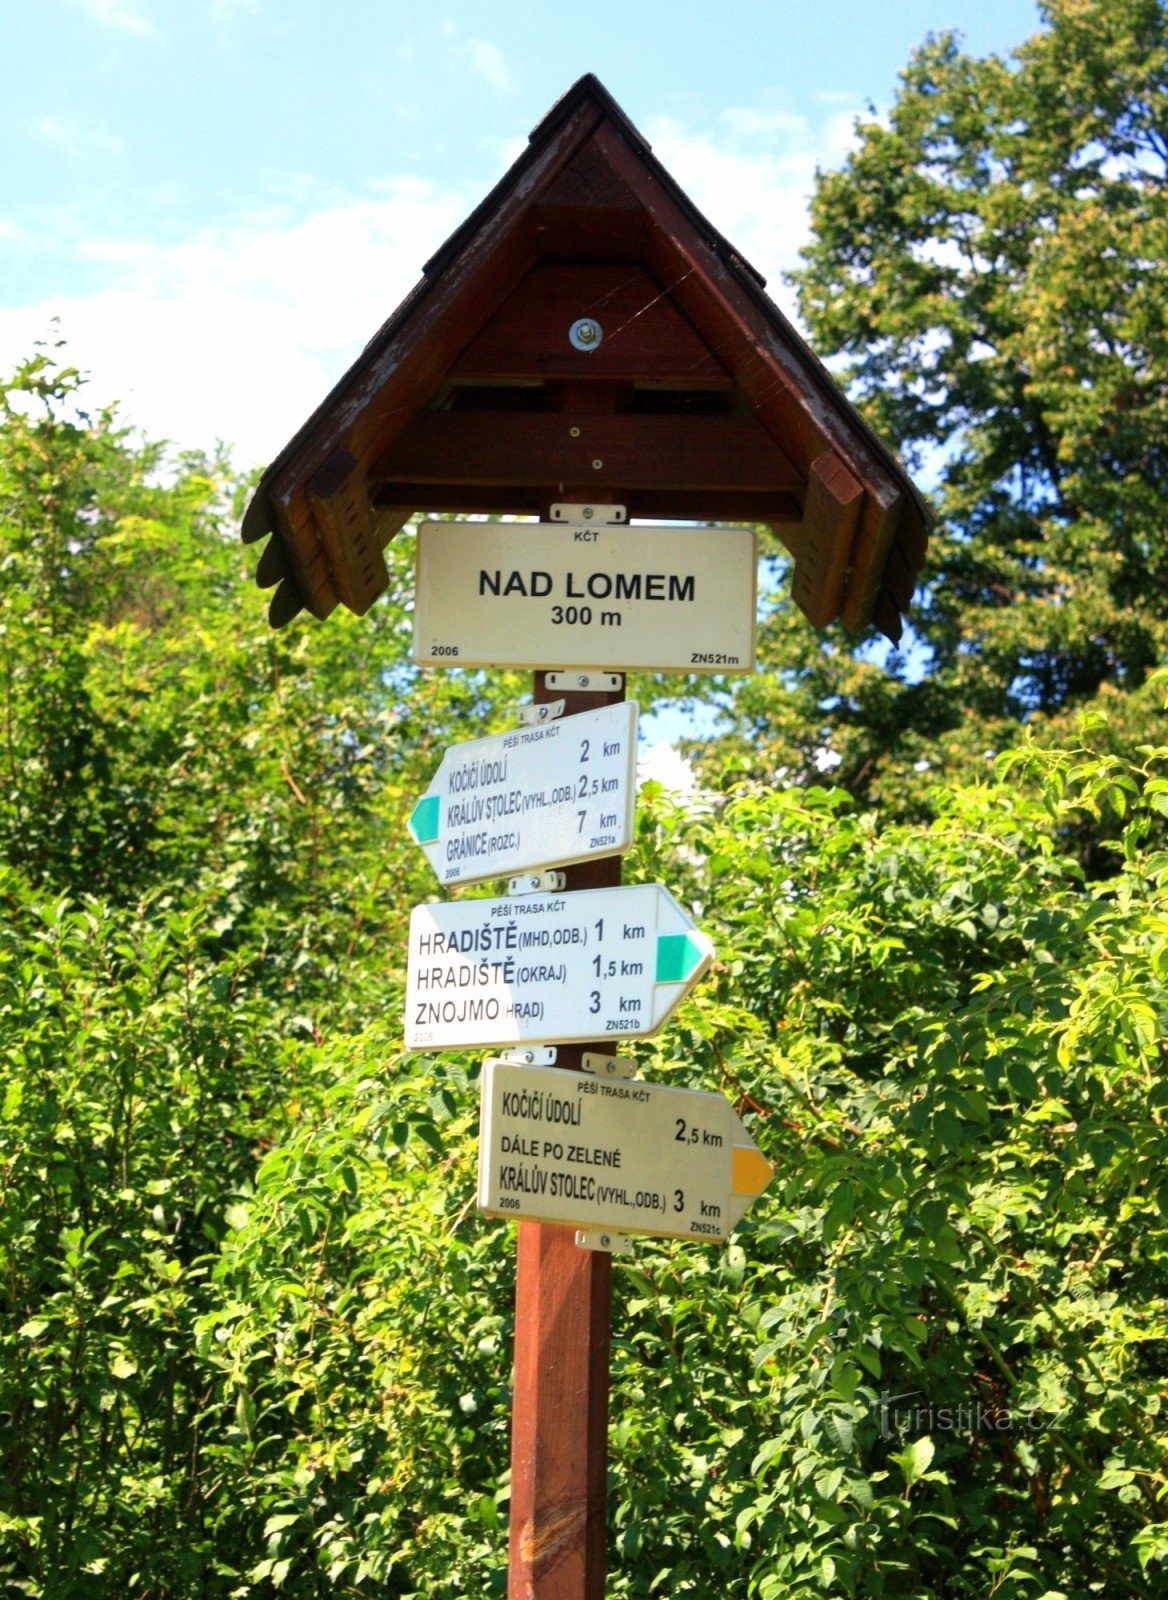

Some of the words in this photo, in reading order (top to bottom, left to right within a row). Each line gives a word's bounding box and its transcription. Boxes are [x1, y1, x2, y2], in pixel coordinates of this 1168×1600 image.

[574, 530, 600, 543] KČT
[479, 569, 553, 597] NAD
[565, 573, 696, 602] LOMEM
[551, 606, 592, 625] 300
[601, 611, 622, 626] m
[431, 646, 459, 657] 2006
[690, 653, 739, 665] ZN521m
[521, 731, 544, 744] TRASA
[545, 726, 561, 739] KČT
[580, 739, 590, 763] 2
[603, 741, 621, 758] km
[449, 760, 479, 795] KOČIČÍ
[480, 753, 508, 787] ÚDOLÍ
[578, 774, 599, 799] 2,5
[601, 777, 619, 793] km
[577, 810, 588, 834] 7
[600, 812, 617, 829] km
[589, 835, 616, 849] ZN521a
[514, 904, 545, 916] TRASA
[547, 900, 567, 912] KČT
[594, 918, 604, 942] 1
[623, 923, 645, 940] km
[592, 954, 616, 979] 1,5
[620, 959, 643, 976] km
[415, 997, 500, 1025] ZNOJMO
[589, 991, 601, 1014] 3
[619, 996, 641, 1012] km
[605, 1019, 641, 1031] ZN521b
[600, 1086, 631, 1099] TRASA
[632, 1090, 651, 1103] KČT
[502, 1088, 544, 1121] KOČIČÍ
[545, 1093, 582, 1126] ÚDOLÍ
[675, 1118, 699, 1145] 2,5
[703, 1129, 723, 1148] km
[501, 1134, 539, 1157] DÁLE
[543, 1142, 564, 1161] PO
[567, 1147, 622, 1169] ZELENÉ
[499, 1197, 521, 1210] 2006
[673, 1190, 685, 1213] 3
[700, 1200, 721, 1218] km
[690, 1221, 721, 1235] ZN521c
